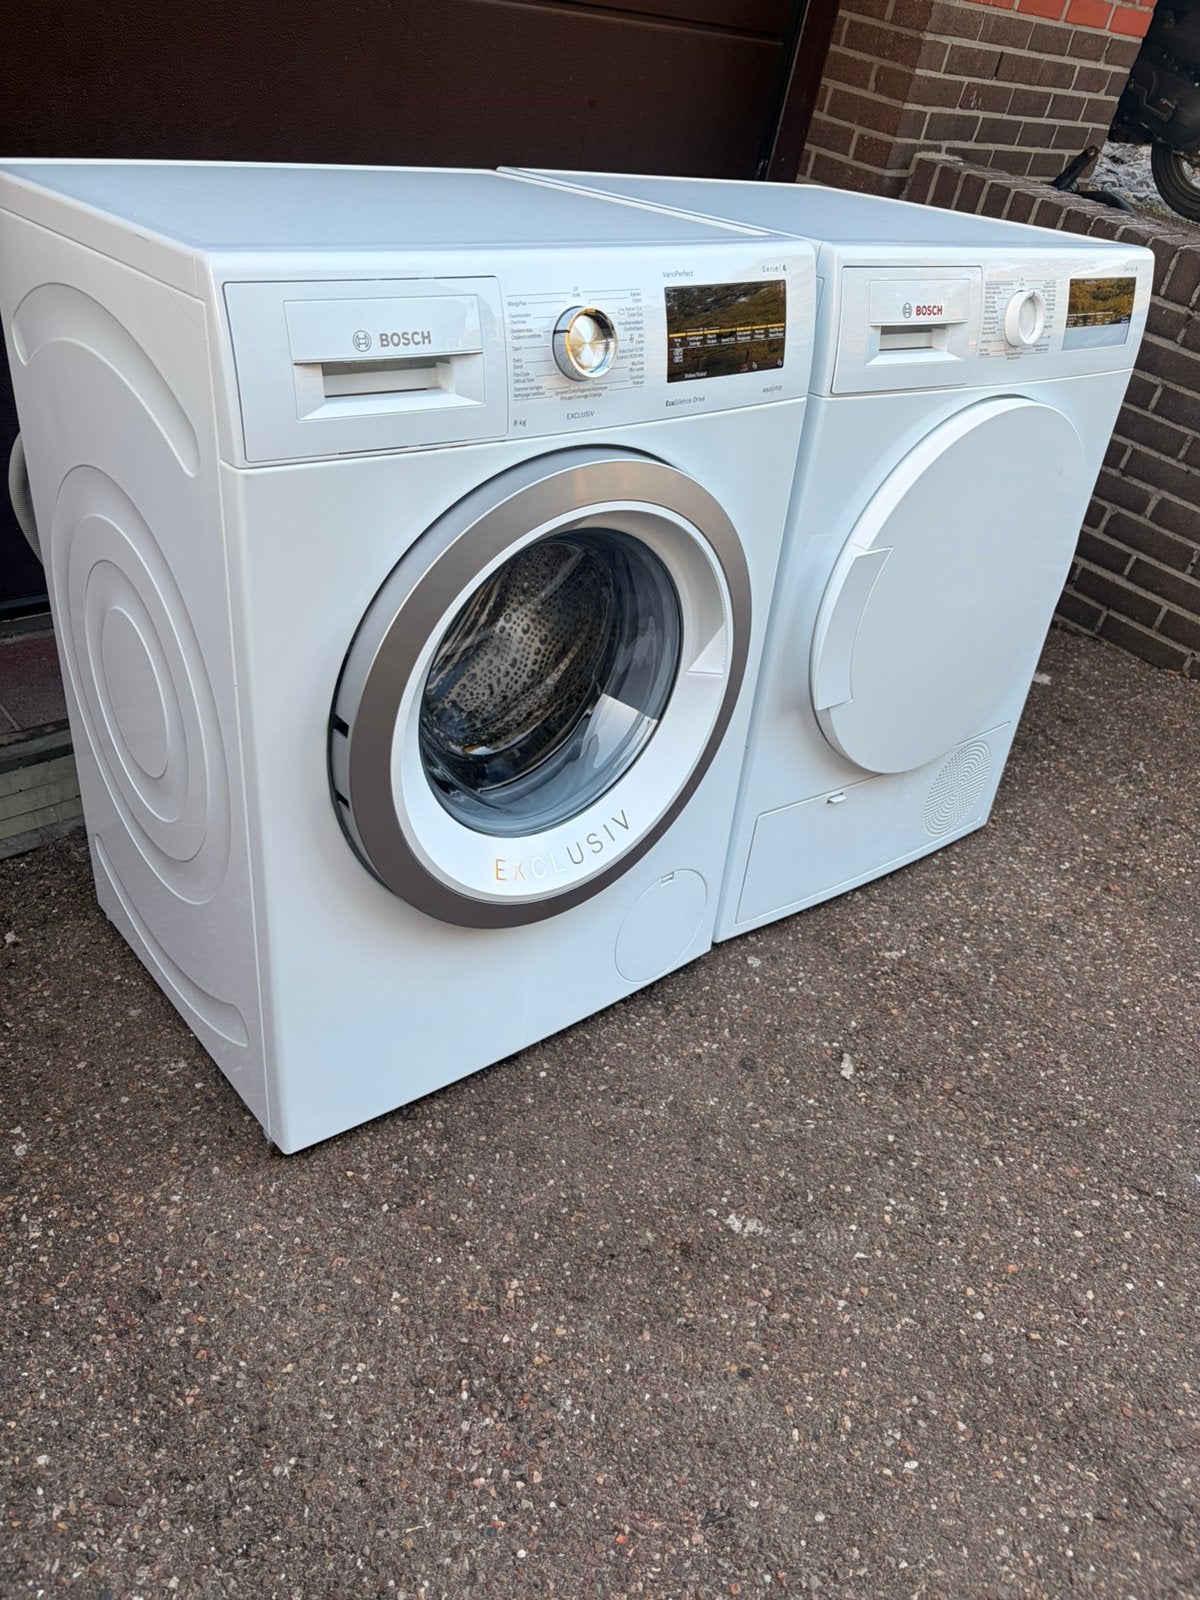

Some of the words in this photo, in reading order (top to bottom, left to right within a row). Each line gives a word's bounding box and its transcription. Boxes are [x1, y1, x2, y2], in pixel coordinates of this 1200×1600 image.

[662, 270, 694, 278] VarioPerfect
[915, 305, 943, 316] BOSCH
[379, 330, 432, 348] BOSCH
[665, 398, 692, 407] EcoSilence
[566, 410, 595, 420] EXCLUSIV
[513, 419, 518, 427] 8
[519, 418, 527, 427] kg
[494, 809, 629, 882] EXCLUSIV
